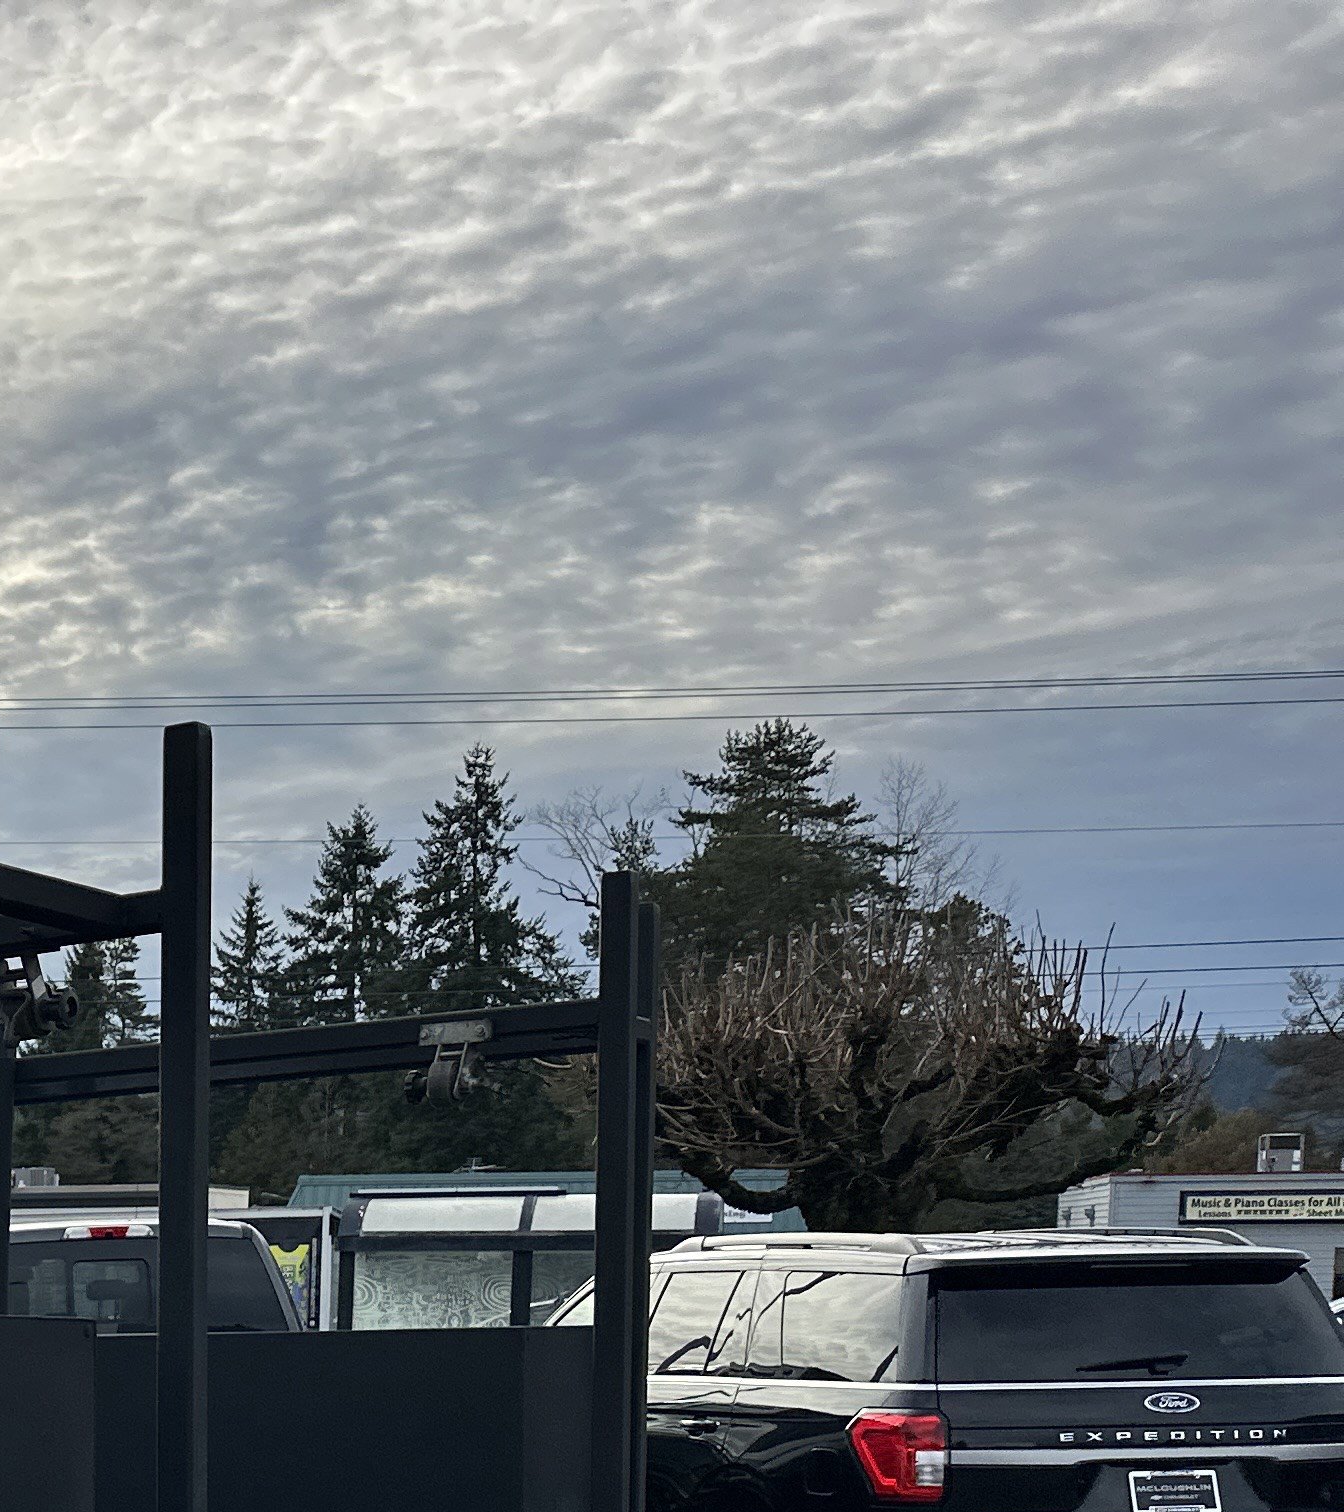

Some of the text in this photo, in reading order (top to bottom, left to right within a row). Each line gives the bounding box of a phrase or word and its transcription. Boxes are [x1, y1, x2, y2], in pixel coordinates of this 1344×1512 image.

[1191, 1198, 1221, 1208] Music
[1223, 1198, 1232, 1208] &
[1234, 1198, 1265, 1208] Piano
[1267, 1197, 1306, 1208] Classes
[1308, 1197, 1323, 1208] for
[1326, 1197, 1341, 1207] All
[1198, 1210, 1232, 1218] Lessons
[1158, 1395, 1188, 1409] Ford
[1059, 1429, 1287, 1442] EXPEDITION
